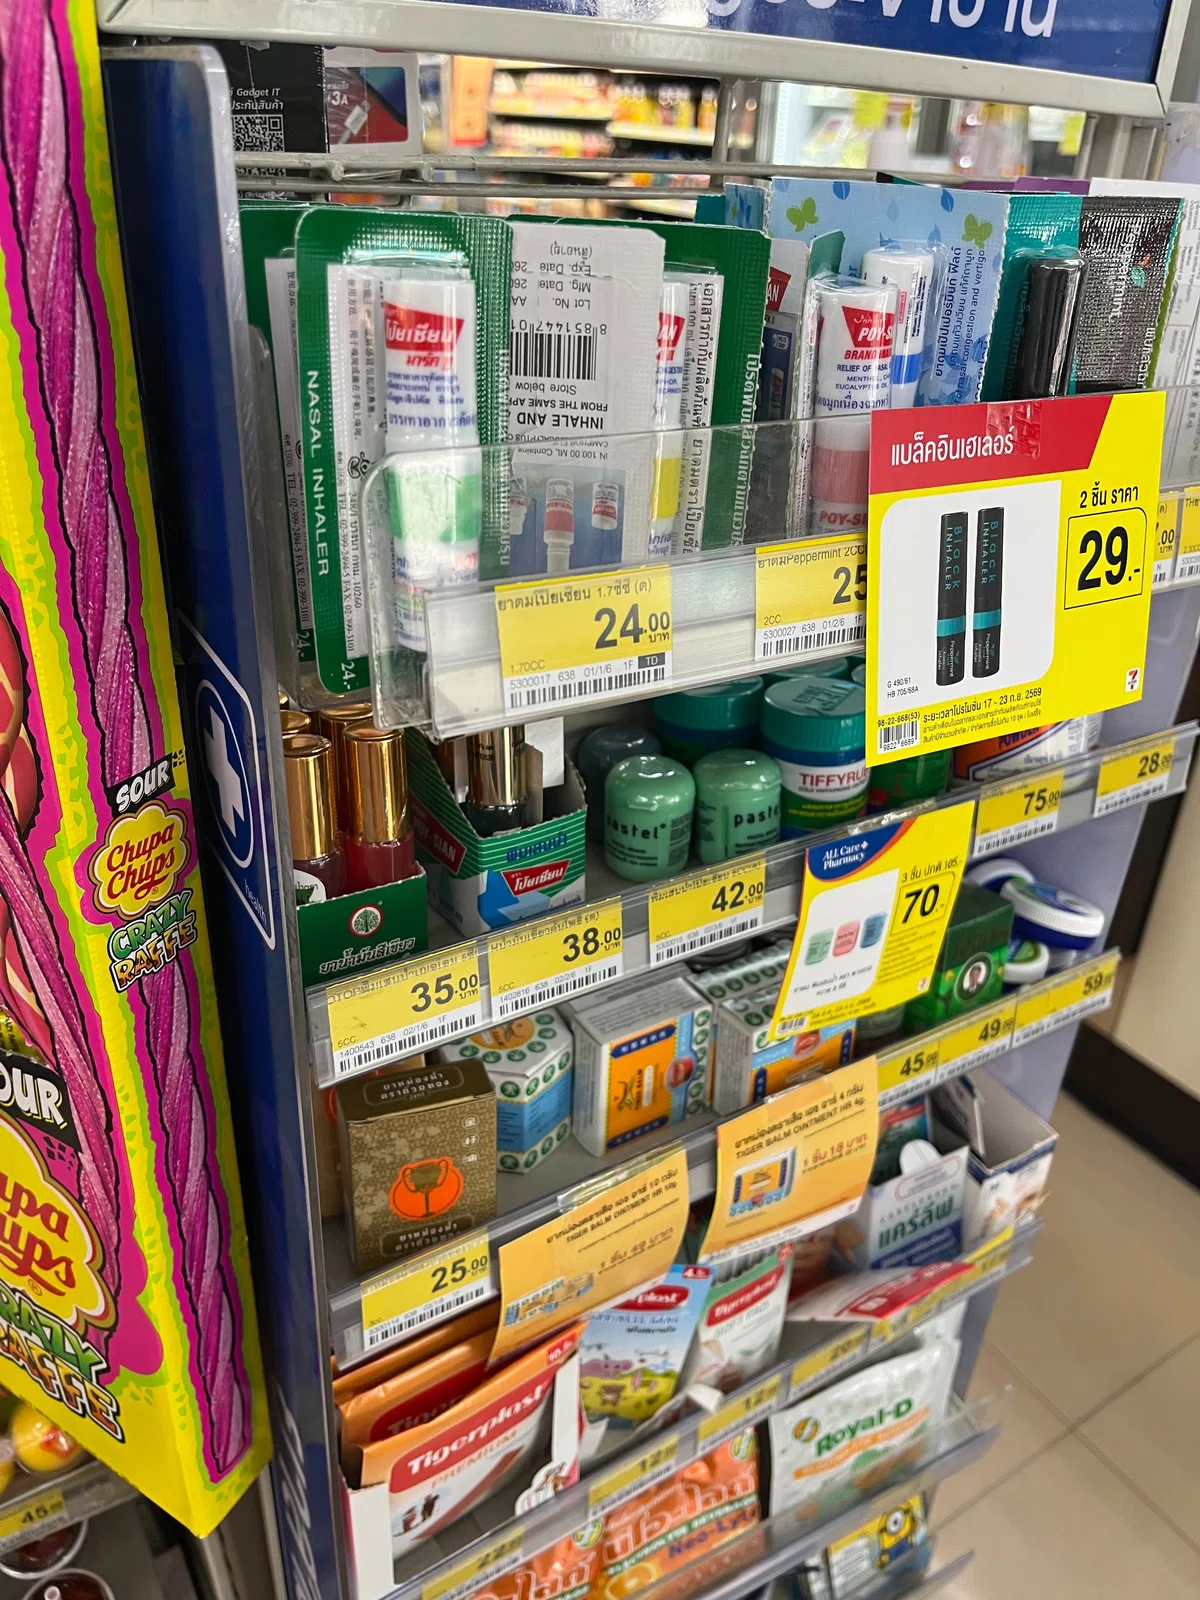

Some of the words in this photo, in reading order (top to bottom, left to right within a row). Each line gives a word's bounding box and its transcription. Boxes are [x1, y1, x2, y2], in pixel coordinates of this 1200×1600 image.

[237, 87, 269, 99] Gadget
[271, 87, 281, 97] IT
[539, 262, 563, 275] Date
[568, 262, 591, 276] Exp.
[974, 249, 987, 286] vertigo
[539, 279, 564, 292] Date
[569, 280, 591, 293] Mfg.
[552, 297, 570, 309] No.
[574, 298, 591, 310] Lot
[970, 287, 980, 307] and
[960, 308, 976, 363] congestion
[837, 364, 860, 372] RELIEF
[862, 364, 872, 372] OF
[515, 382, 545, 394] below
[549, 383, 577, 396] Store
[306, 370, 322, 457] NASAL
[528, 398, 557, 409] SAME
[559, 399, 578, 410] THE
[580, 401, 608, 412] FROM
[516, 412, 547, 426] AND
[551, 413, 604, 430] INHALE
[555, 448, 567, 458] ML
[890, 425, 1015, 467] แบล็คอินเฮเลอร์
[1079, 491, 1088, 509] 2
[1091, 481, 1107, 507] ชิ้น
[1110, 485, 1139, 504] ราคา
[312, 468, 329, 576] INHALER
[944, 526, 953, 591] INHALER
[980, 521, 990, 585] INHALER
[1077, 525, 1141, 592] 29.-
[594, 603, 671, 650] 24.00
[648, 630, 670, 643] บาท
[763, 626, 797, 640] 5300027
[801, 623, 816, 634] 638
[822, 618, 845, 630] 01/2/6
[510, 659, 546, 675] 1.70CC
[510, 674, 551, 690] 5300017
[558, 669, 576, 682] 638
[584, 664, 612, 678] 01/1/6
[645, 655, 659, 667] TD
[923, 698, 981, 724] ระยะเวลาโปรโมชั่น
[983, 697, 992, 710] 17
[999, 694, 1008, 706] 23
[1025, 686, 1042, 699] 2569
[116, 758, 170, 813] SOUR
[107, 822, 175, 872] Chupa
[822, 846, 840, 861] ALL
[840, 843, 861, 856] Care
[823, 851, 866, 871] Pharmacy
[107, 846, 175, 900] Chups
[513, 866, 565, 893] โป๊ยเซียน
[901, 873, 908, 882] 3
[711, 881, 764, 912] 42.00
[111, 891, 191, 960] CRAZY
[112, 914, 197, 990] RAFFE
[320, 937, 416, 974] ยาน้ำมันสีเขียว
[562, 927, 622, 963] 38.00
[604, 940, 621, 952] บาท
[410, 973, 479, 1013] 35.00
[459, 987, 479, 1000] บาท
[500, 987, 530, 1002] 1402816
[535, 981, 548, 991] 638
[337, 1035, 360, 1048] 5CC.
[339, 1041, 375, 1058] 1400543
[380, 1032, 396, 1045] 638
[403, 1022, 428, 1036] 02/1/6
[408, 1383, 546, 1475] Tigerplast
[816, 1397, 913, 1457] Royal-D
